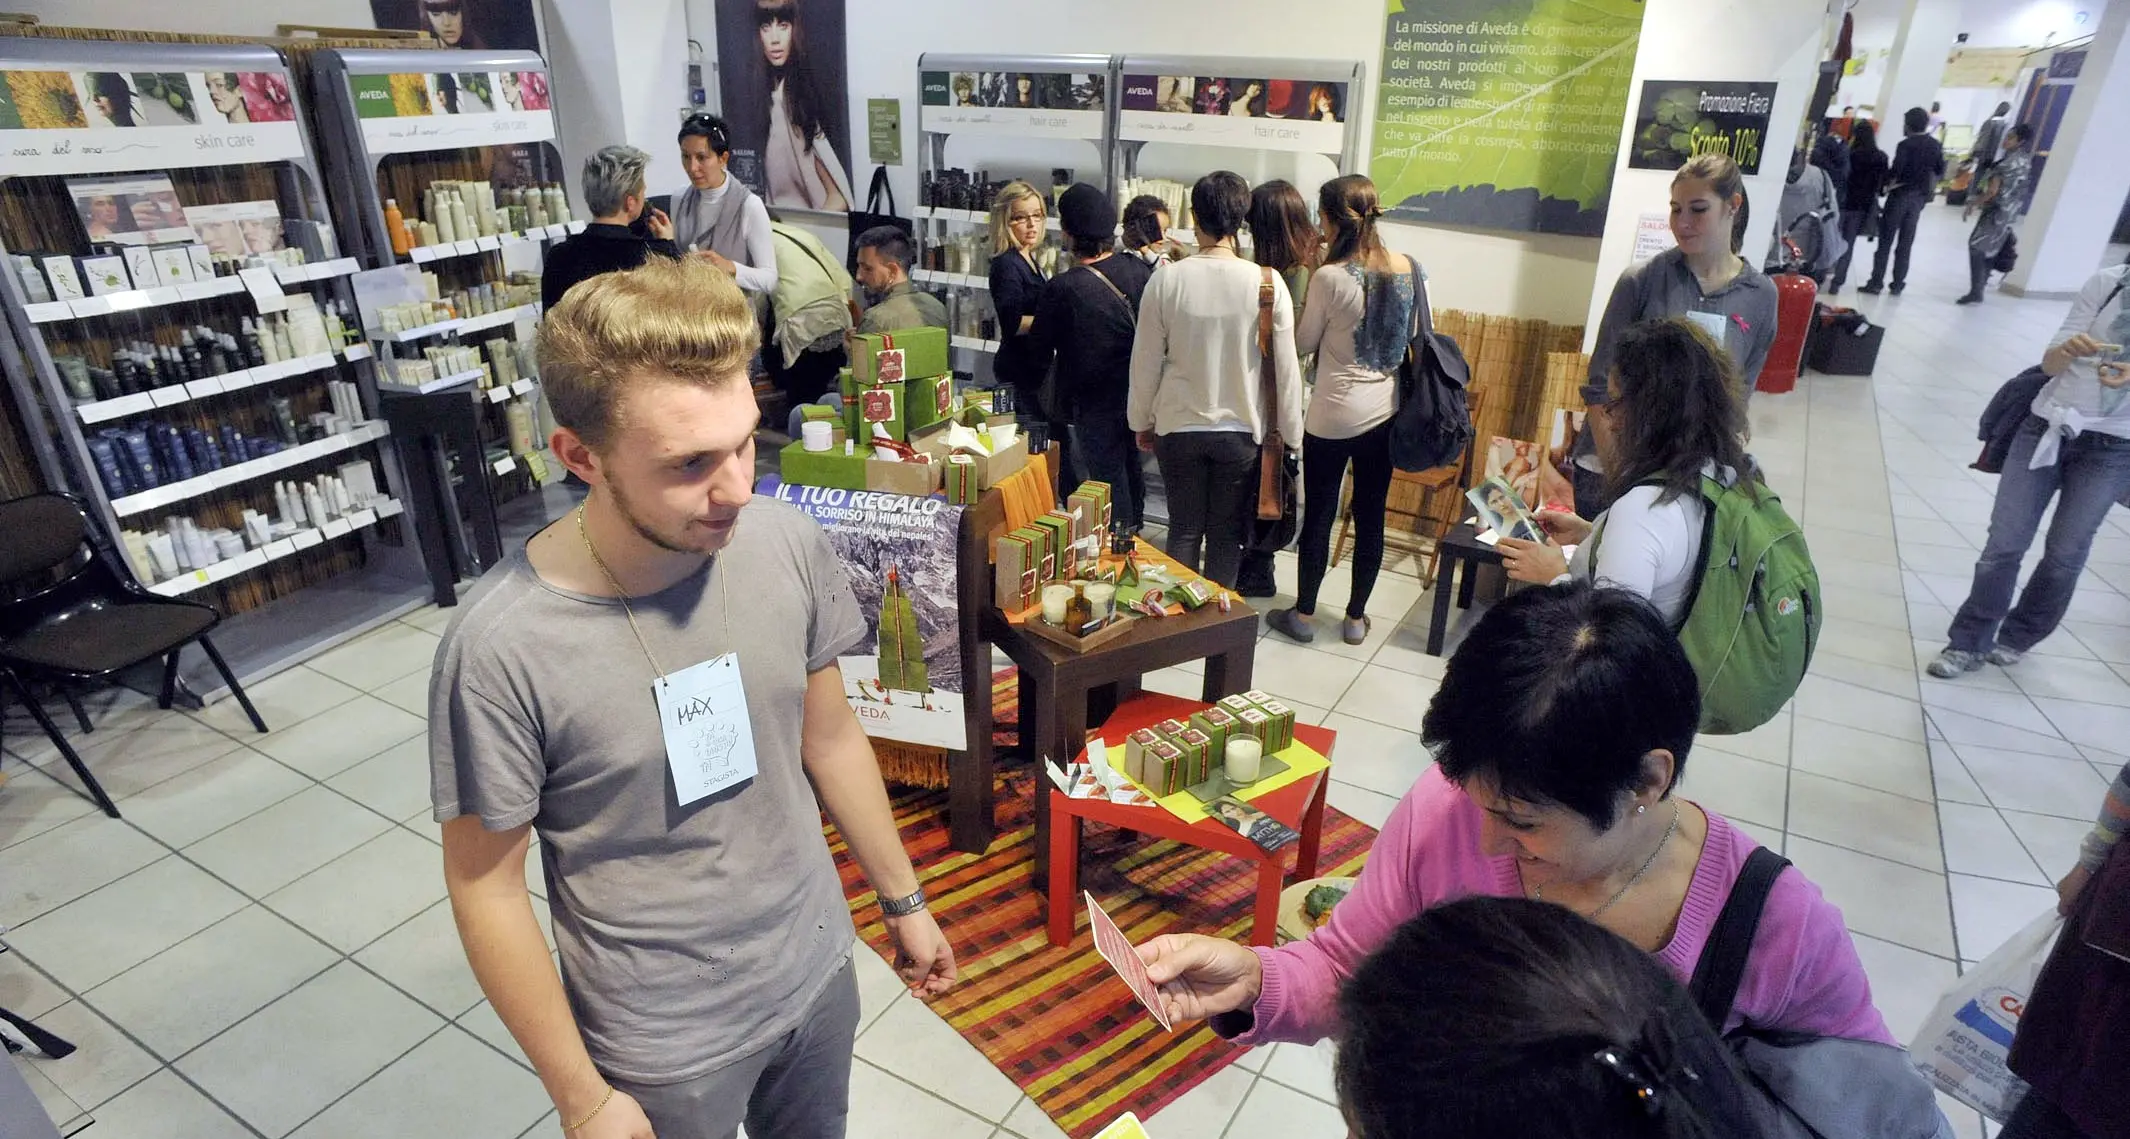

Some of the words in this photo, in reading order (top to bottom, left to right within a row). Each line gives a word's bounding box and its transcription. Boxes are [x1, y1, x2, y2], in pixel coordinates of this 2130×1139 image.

[1395, 20, 1409, 33] La
[1412, 20, 1463, 34] missione
[1466, 21, 1478, 34] di
[1480, 22, 1518, 35] Aveda
[1532, 24, 1544, 36] di
[1393, 38, 1411, 52] del
[1413, 39, 1454, 52] mondo
[1456, 39, 1467, 53] in
[1469, 40, 1487, 53] cui
[1391, 57, 1410, 70] dei
[1417, 58, 1450, 71] nostri
[1458, 60, 1506, 74] prodotti
[1514, 61, 1526, 74] al
[1127, 86, 1153, 96] AVEDA
[1389, 75, 1433, 89] società.
[1440, 77, 1476, 90] Aveda
[1483, 79, 1493, 92] si
[359, 90, 389, 100] AVEDA
[1387, 94, 1435, 109] esempio
[1436, 95, 1448, 108] di
[1699, 90, 1747, 113] Promozione
[1746, 92, 1769, 114] Fiera
[1029, 115, 1047, 126] hair
[1048, 118, 1068, 128] care
[1385, 111, 1403, 122] nel
[1406, 112, 1450, 127] rispetto
[1254, 125, 1275, 138] hair
[1277, 127, 1301, 140] care
[1384, 128, 1404, 141] che
[1408, 131, 1421, 141] va
[12, 148, 42, 157] cura
[52, 139, 72, 155] del
[194, 133, 223, 150] skin
[227, 136, 255, 148] care
[1689, 126, 1731, 160] Sconto
[1733, 128, 1761, 167] 10%
[775, 482, 793, 502] IL
[799, 485, 847, 506] TUO
[849, 490, 942, 515] REGALO
[804, 505, 814, 517] IL
[815, 506, 863, 521] SORRISO
[865, 511, 877, 523] IN
[822, 522, 862, 536] migliorano
[888, 528, 899, 538] dei
[901, 530, 934, 542] nepalesi
[677, 696, 714, 726] MAX
[854, 705, 890, 720] VEDA
[703, 768, 740, 788] STAGISTA
